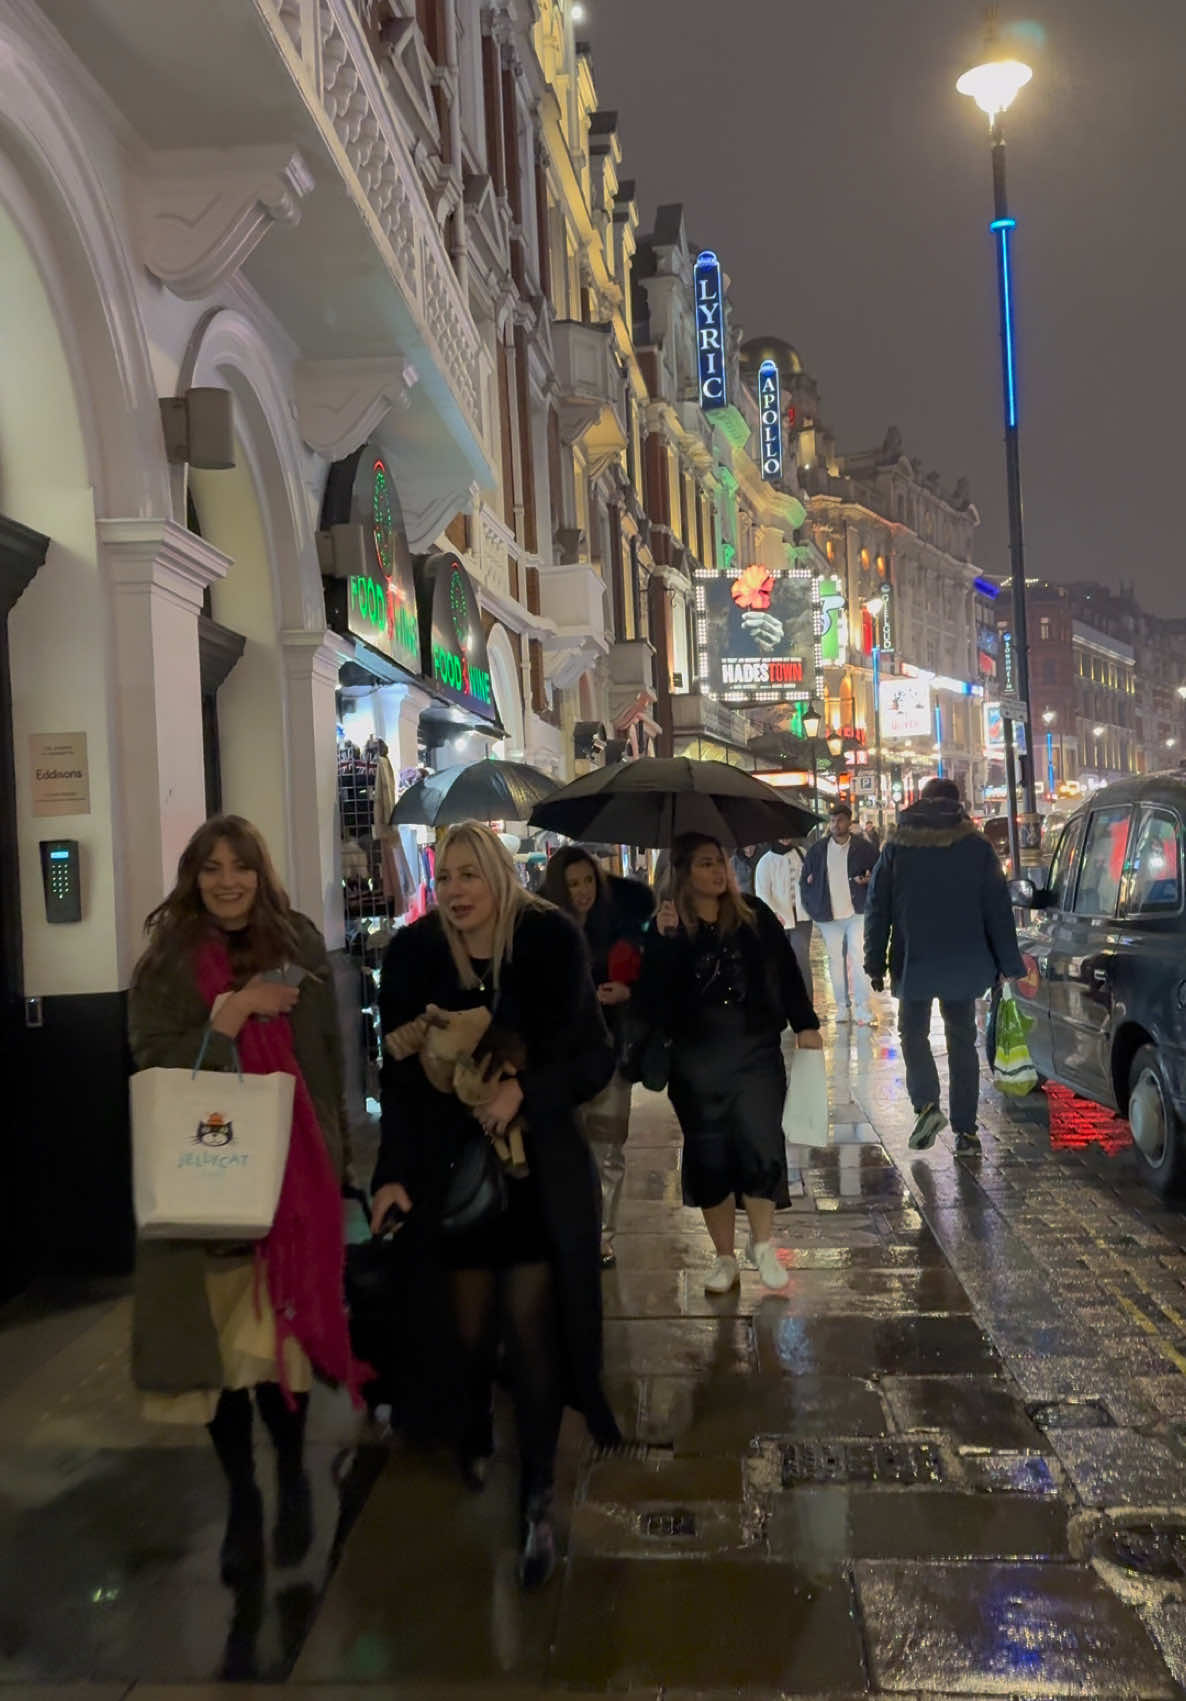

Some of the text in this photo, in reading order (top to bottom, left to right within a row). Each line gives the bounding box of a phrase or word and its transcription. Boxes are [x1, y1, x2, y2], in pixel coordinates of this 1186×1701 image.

[698, 279, 722, 399] LYRIC
[762, 377, 780, 474] APOLLO
[350, 576, 385, 632] FOOD
[433, 646, 491, 705] FOOD WINE
[721, 663, 803, 684] HADESTOWN
